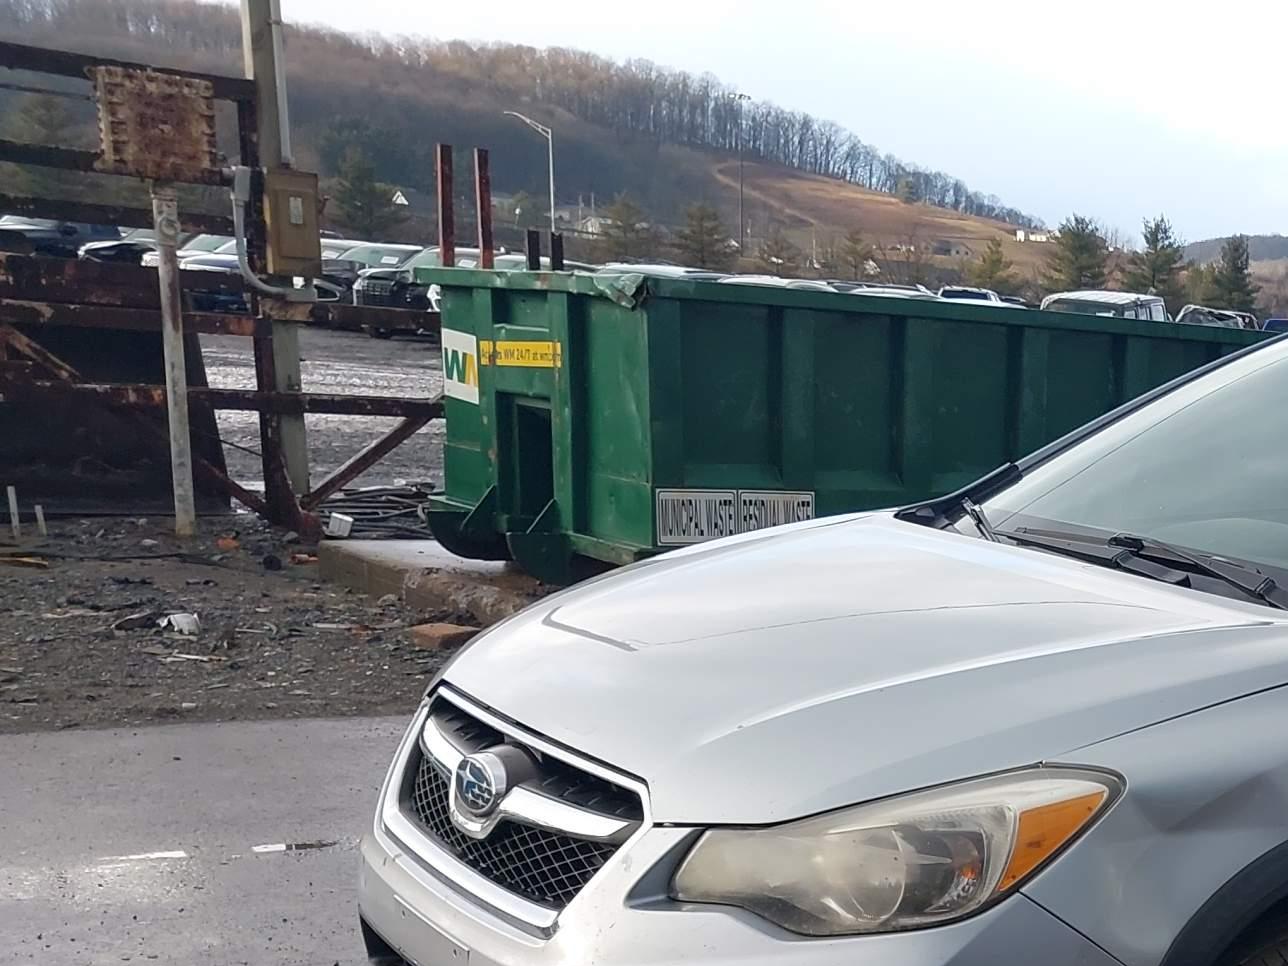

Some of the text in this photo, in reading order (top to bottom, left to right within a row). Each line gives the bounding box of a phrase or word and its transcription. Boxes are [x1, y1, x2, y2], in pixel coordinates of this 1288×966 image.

[661, 499, 734, 536] MUNICIPAL WASTE
[742, 499, 781, 533] RESIDUAL
